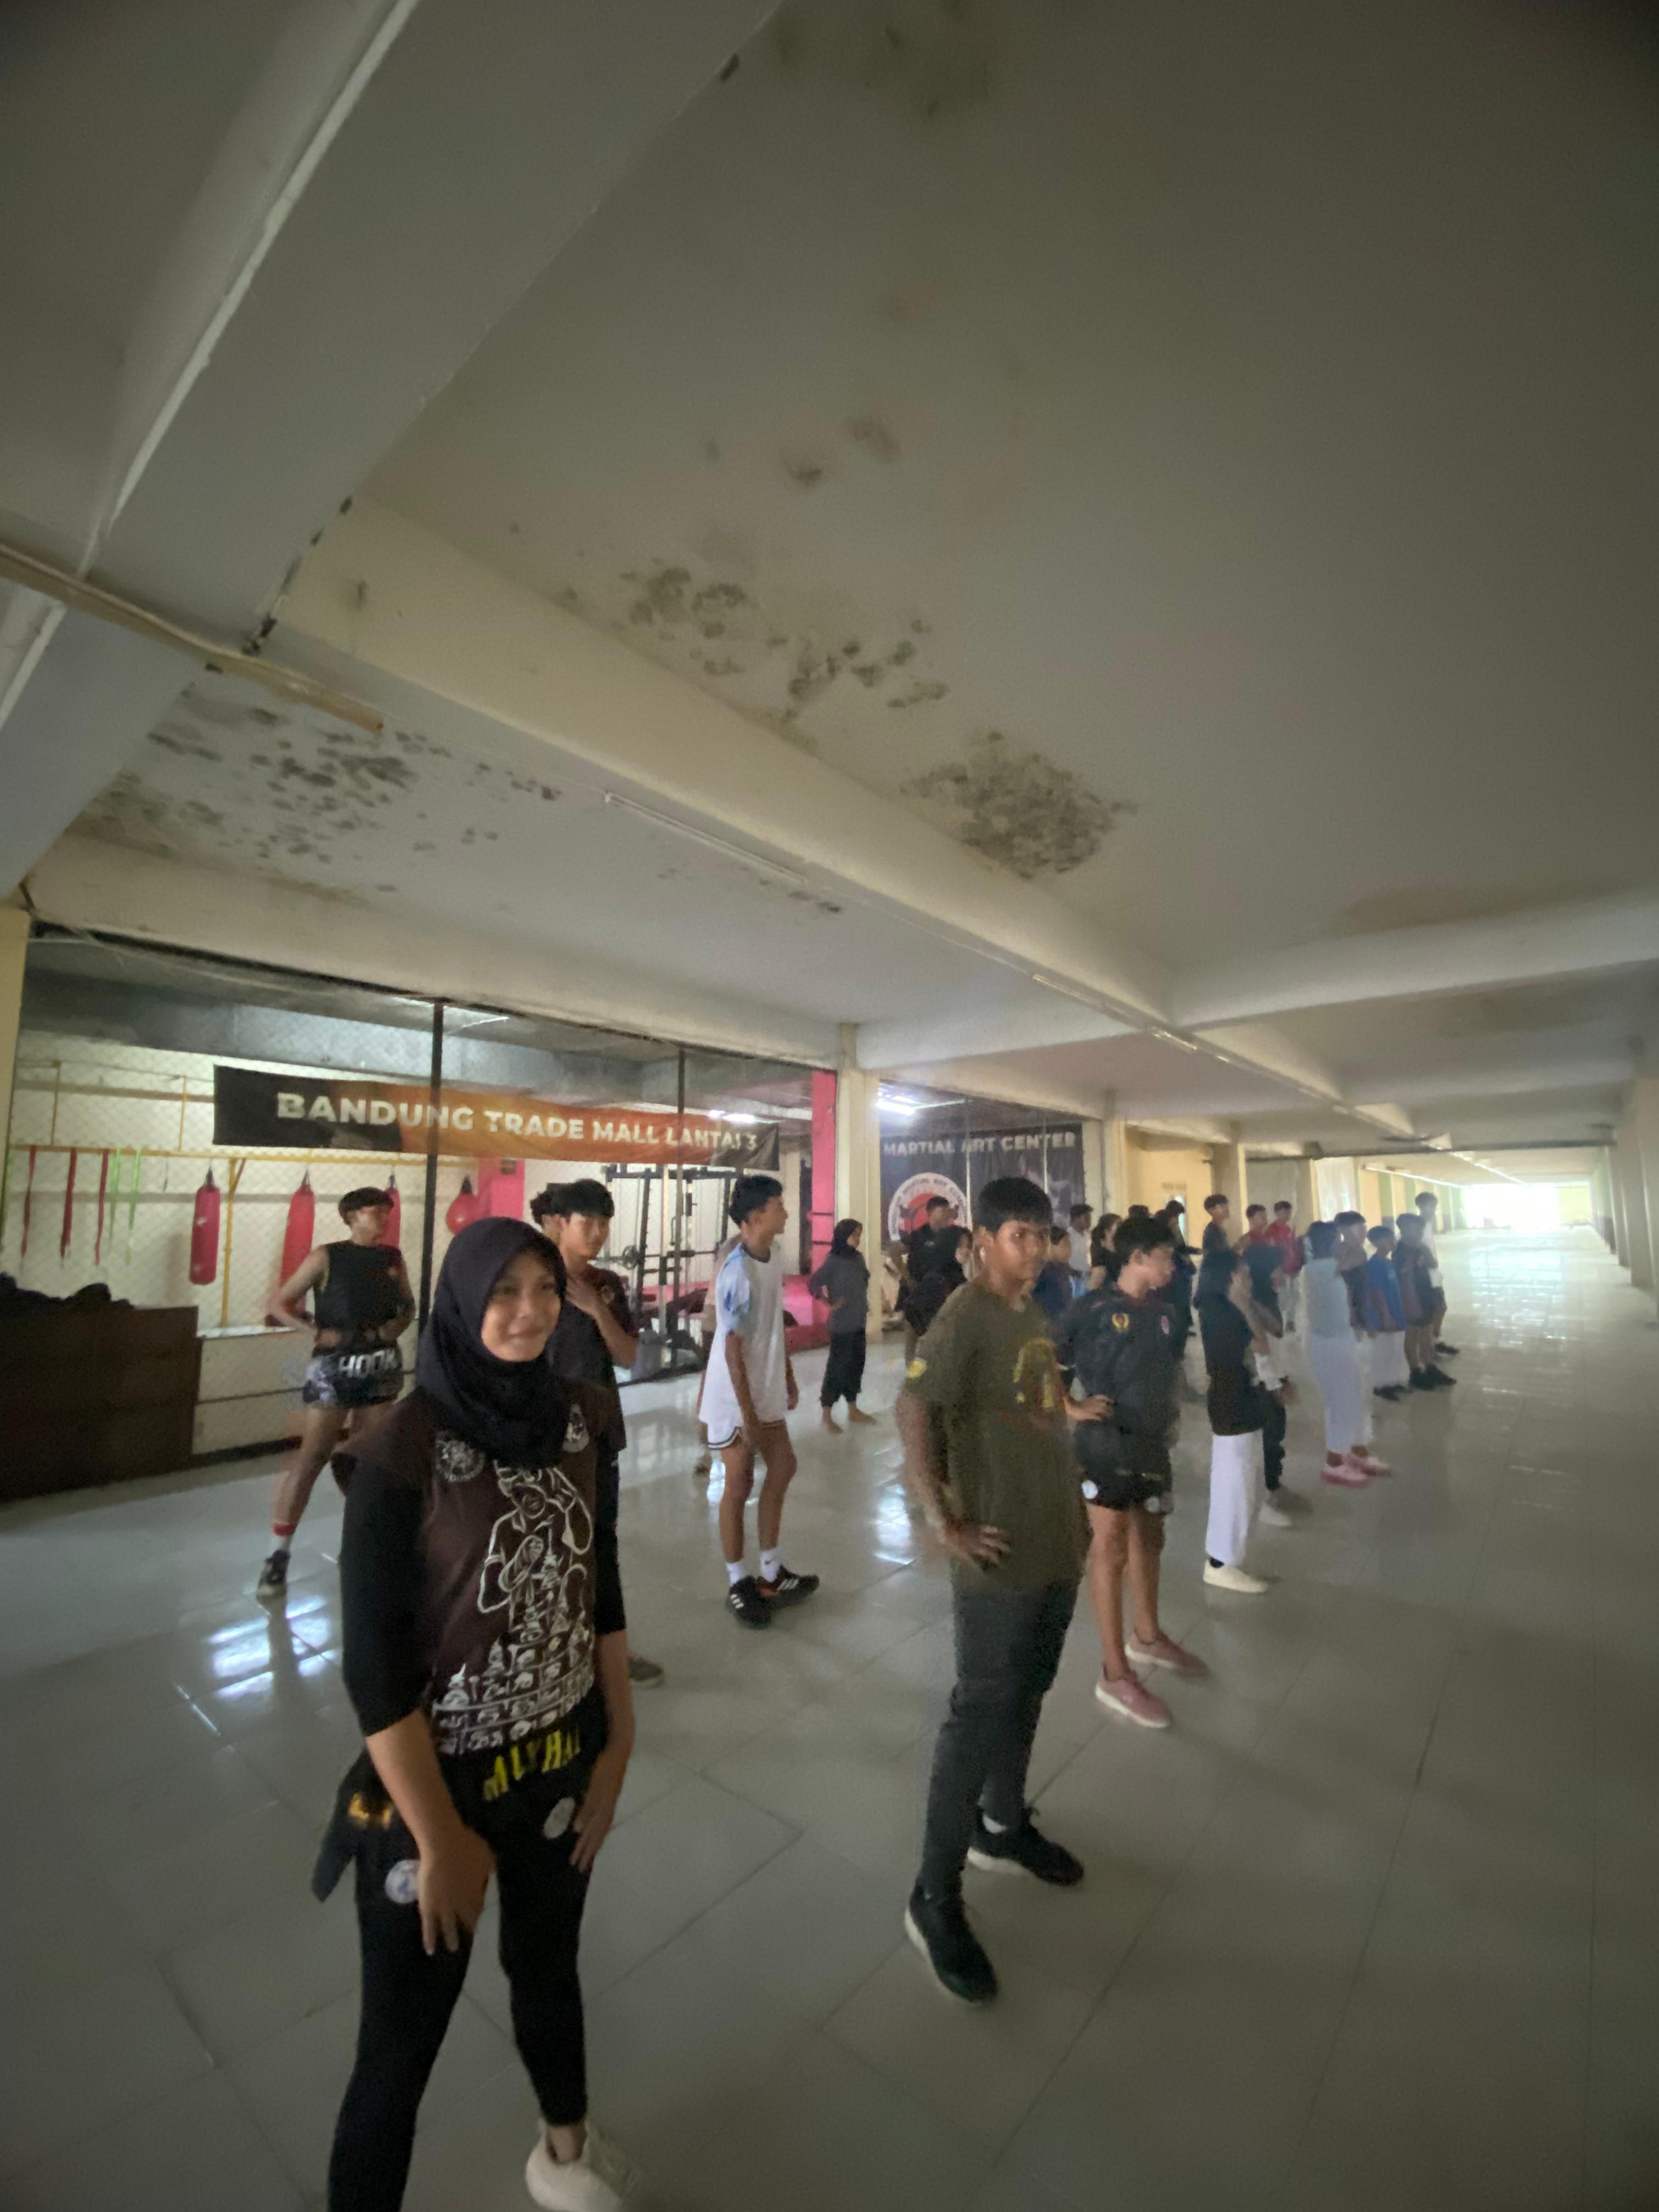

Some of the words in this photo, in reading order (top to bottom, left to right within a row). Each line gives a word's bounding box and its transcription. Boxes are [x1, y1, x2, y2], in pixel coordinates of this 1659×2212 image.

[277, 1092, 473, 1130] BANDUNG
[484, 1110, 584, 1140] TRADE
[593, 1120, 659, 1144] MALL
[666, 1126, 741, 1150] LANTAI
[884, 1140, 956, 1155] MARTIAL
[961, 1137, 996, 1153] ART
[1001, 1132, 1076, 1151] CENTER
